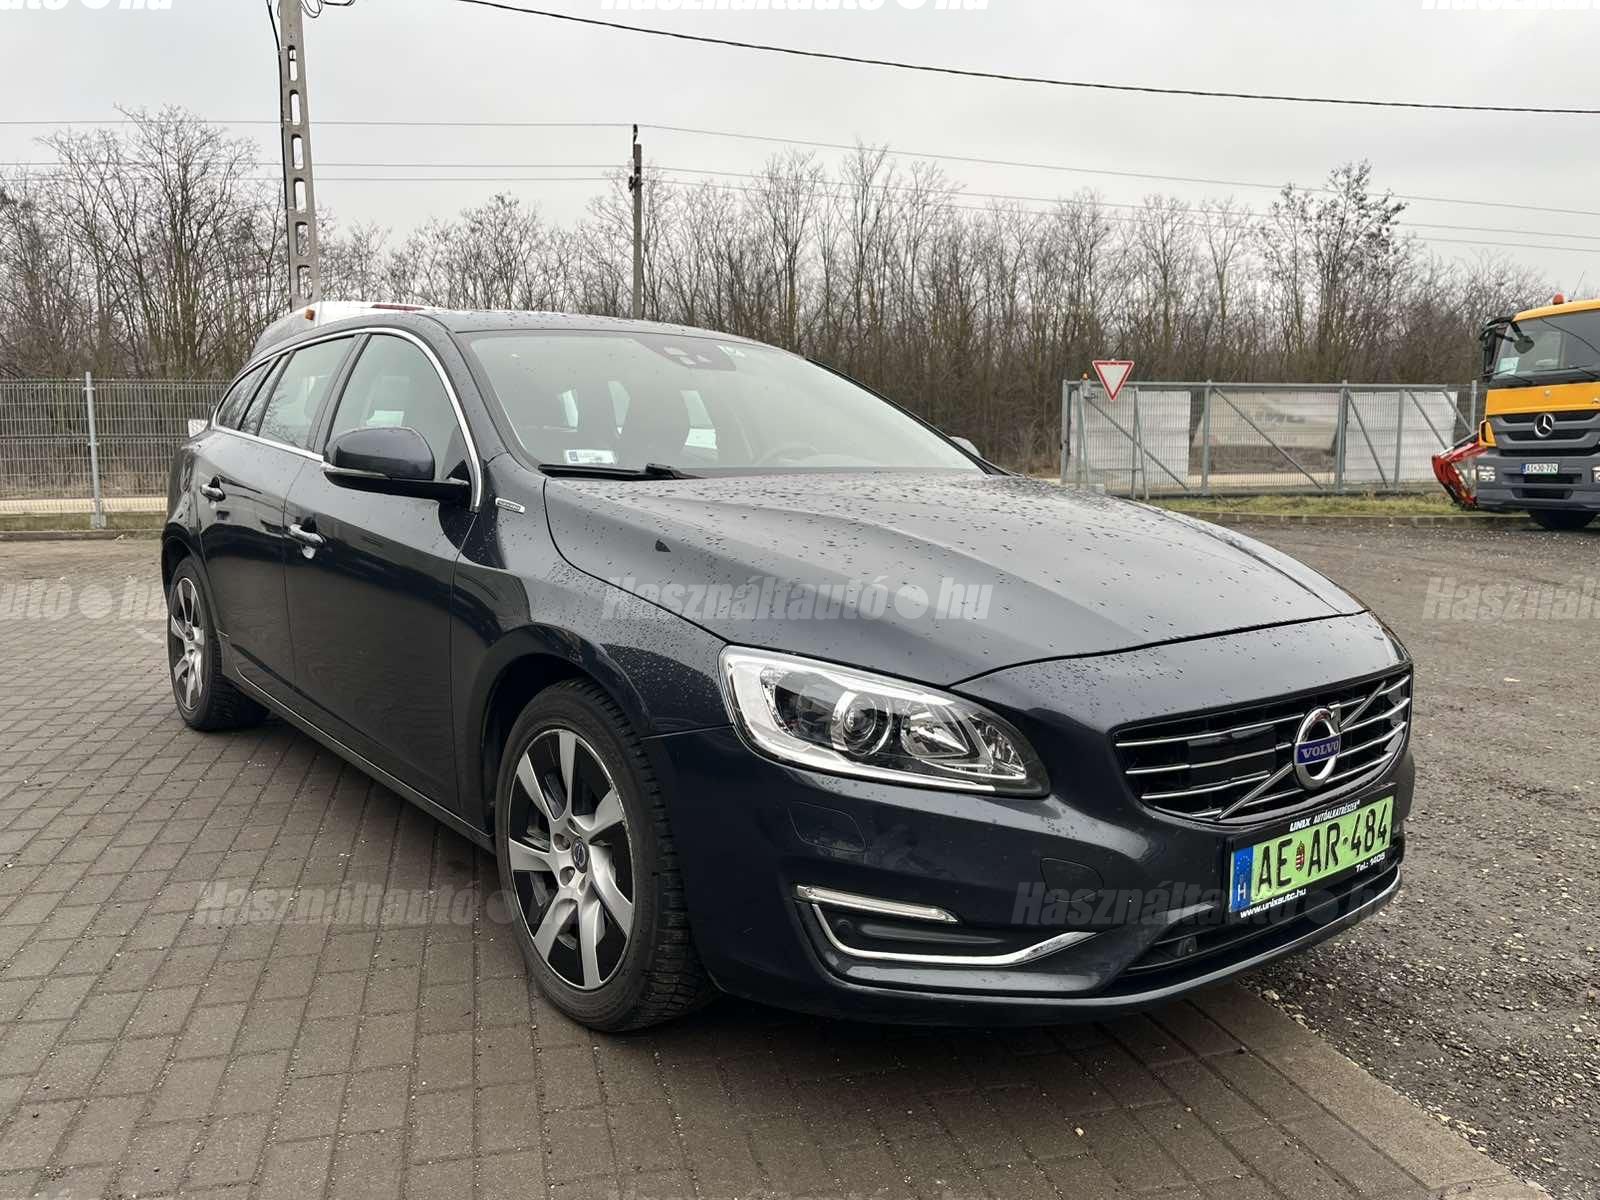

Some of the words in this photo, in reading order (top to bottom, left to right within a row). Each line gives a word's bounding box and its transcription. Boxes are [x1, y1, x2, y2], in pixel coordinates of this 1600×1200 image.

[1301, 741, 1339, 759] VOLVO
[1289, 817, 1312, 832] UNIX
[1256, 838, 1293, 893] AE
[1237, 882, 1247, 902] H
